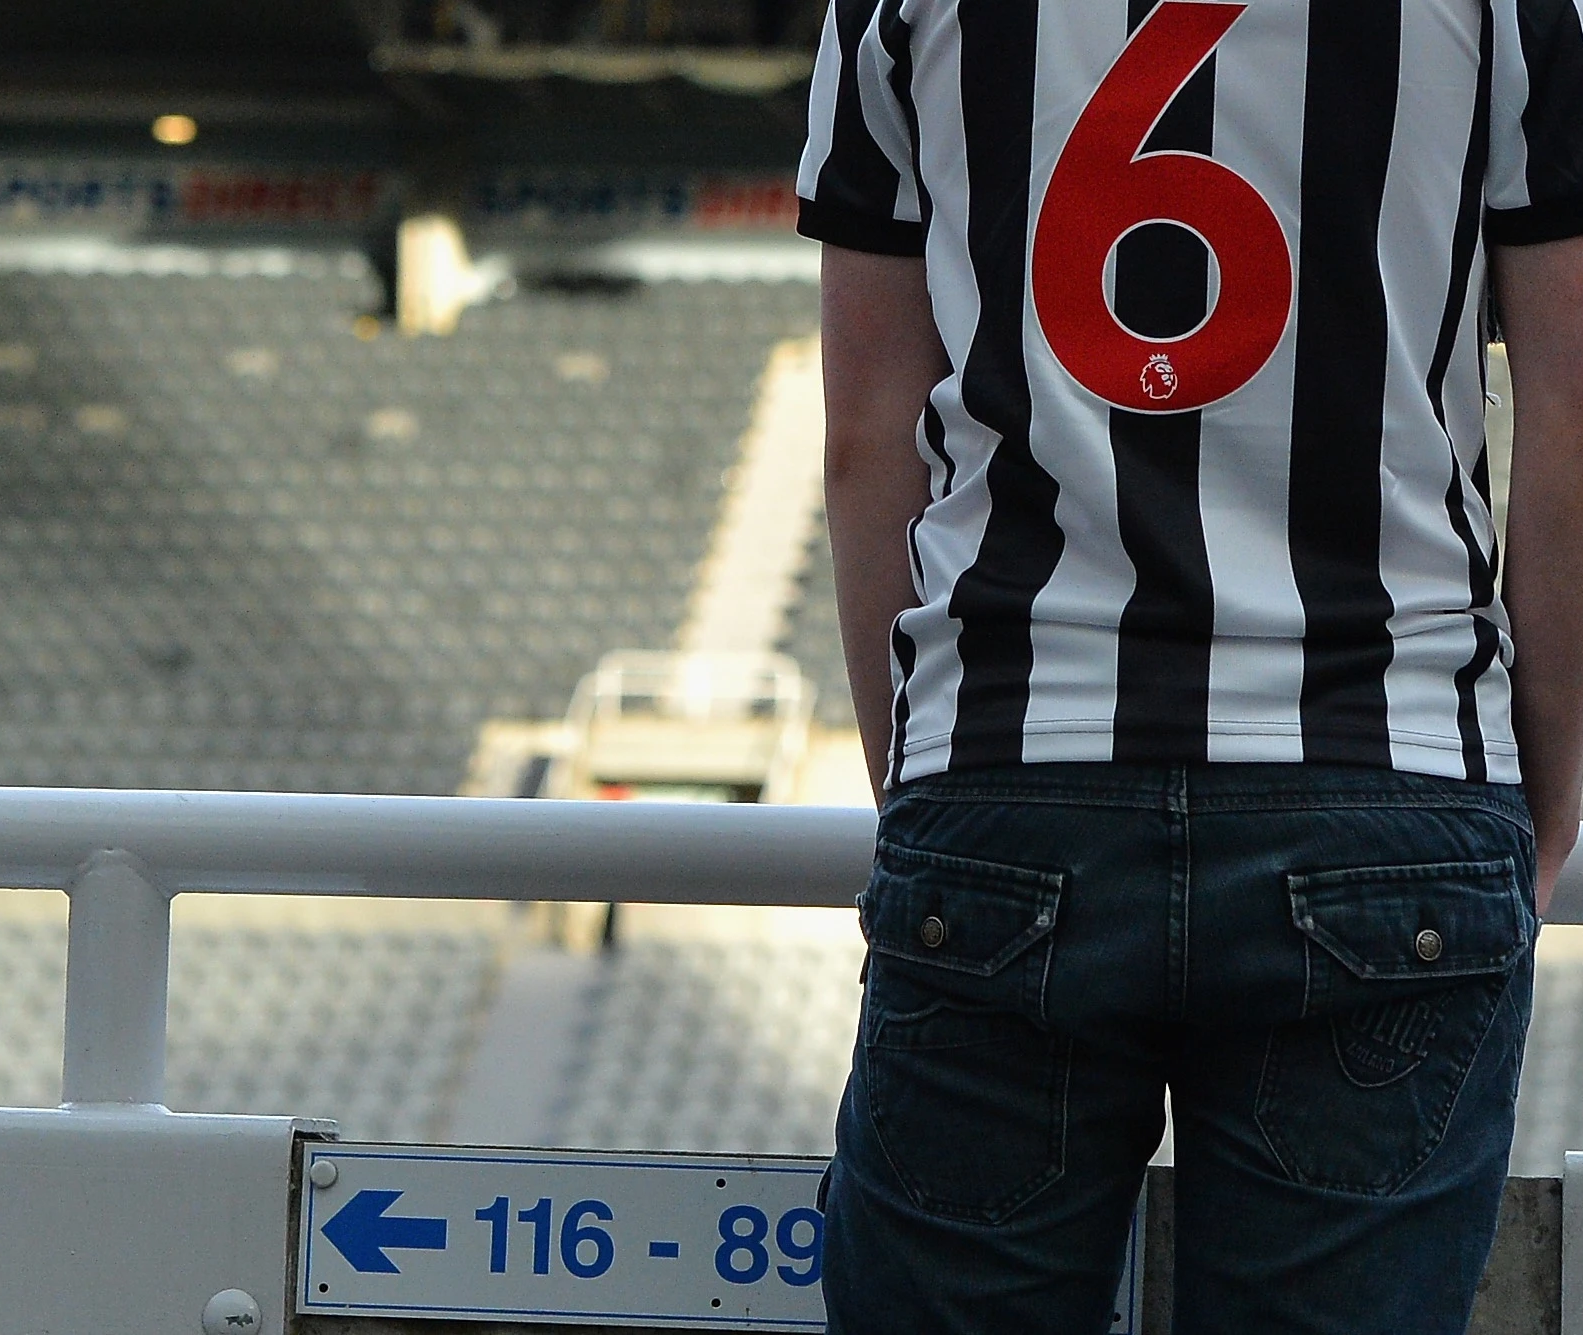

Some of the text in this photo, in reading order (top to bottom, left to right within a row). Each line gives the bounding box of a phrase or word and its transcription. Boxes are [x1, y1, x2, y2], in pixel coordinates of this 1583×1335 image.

[1350, 1000, 1445, 1059] OLICE
[475, 1196, 824, 1287] 116 - 89
